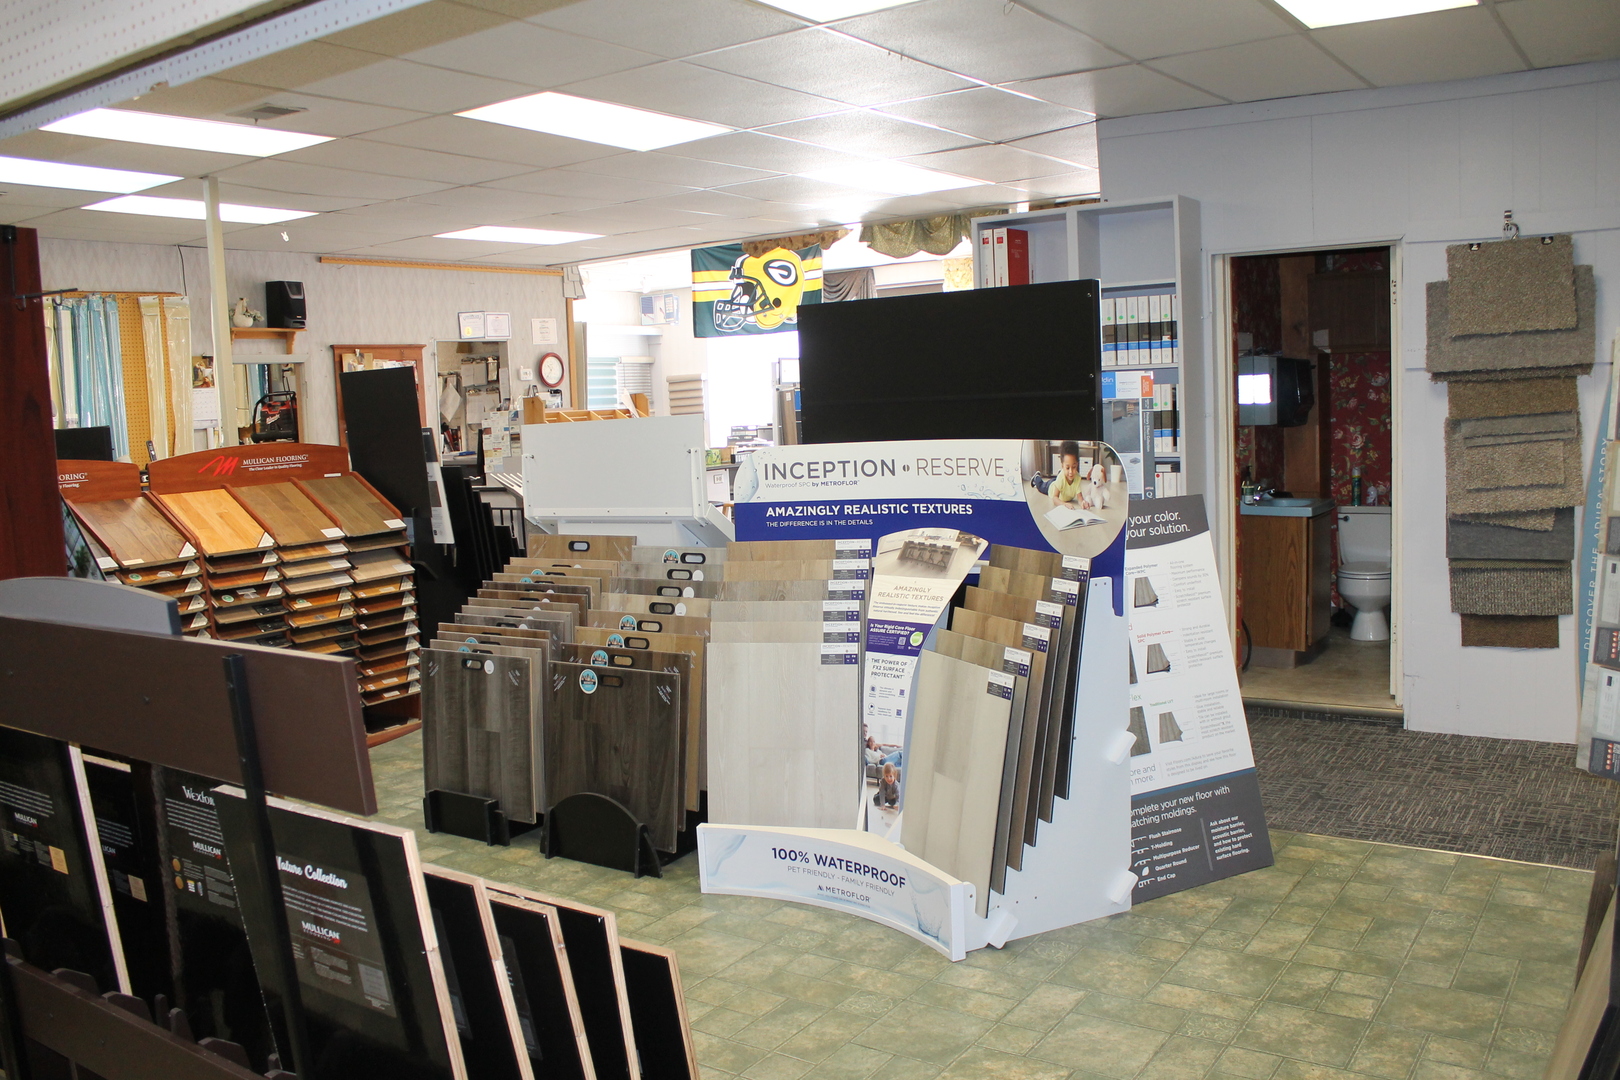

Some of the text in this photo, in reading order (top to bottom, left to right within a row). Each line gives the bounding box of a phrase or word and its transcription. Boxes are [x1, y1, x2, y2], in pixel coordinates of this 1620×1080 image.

[243, 457, 274, 465] MULLICAN
[764, 458, 1005, 481] INCEPTION RESERVE
[766, 503, 973, 517] AMAZINGLY REALISTIC TEXTURES
[1129, 511, 1181, 527] your color.
[1149, 524, 1190, 536] solution.
[893, 585, 932, 593] AMAZINGLY
[878, 592, 909, 600] REALISTIC
[1145, 765, 1156, 773] and
[1134, 775, 1155, 785] more.
[1161, 798, 1177, 810] your
[1179, 796, 1194, 804] new
[1195, 791, 1212, 800] floor
[1214, 785, 1230, 795] with
[1161, 806, 1197, 821] moldings.
[1149, 827, 1182, 839] Flush Stairnose
[1211, 824, 1229, 833] moisture
[1213, 832, 1229, 840] acoustic
[1237, 832, 1252, 841] protect
[193, 841, 222, 855] MULLICAN
[1151, 840, 1173, 850] T-Molding
[1215, 845, 1231, 854] existing
[1153, 844, 1199, 860] Multipurpose Reducer
[1216, 852, 1230, 860] surface
[771, 847, 906, 889] 100% WATERPROOF
[1155, 858, 1187, 871] Quarter Round
[305, 865, 348, 889] Collection
[787, 866, 800, 874] PET
[803, 868, 835, 880] FRIENDLY
[841, 875, 863, 887] FAMILY
[865, 883, 895, 897] FRIENDLY
[1166, 873, 1176, 881] Cap
[825, 886, 870, 903] METROFLOR
[301, 921, 340, 940] MULLICAN
